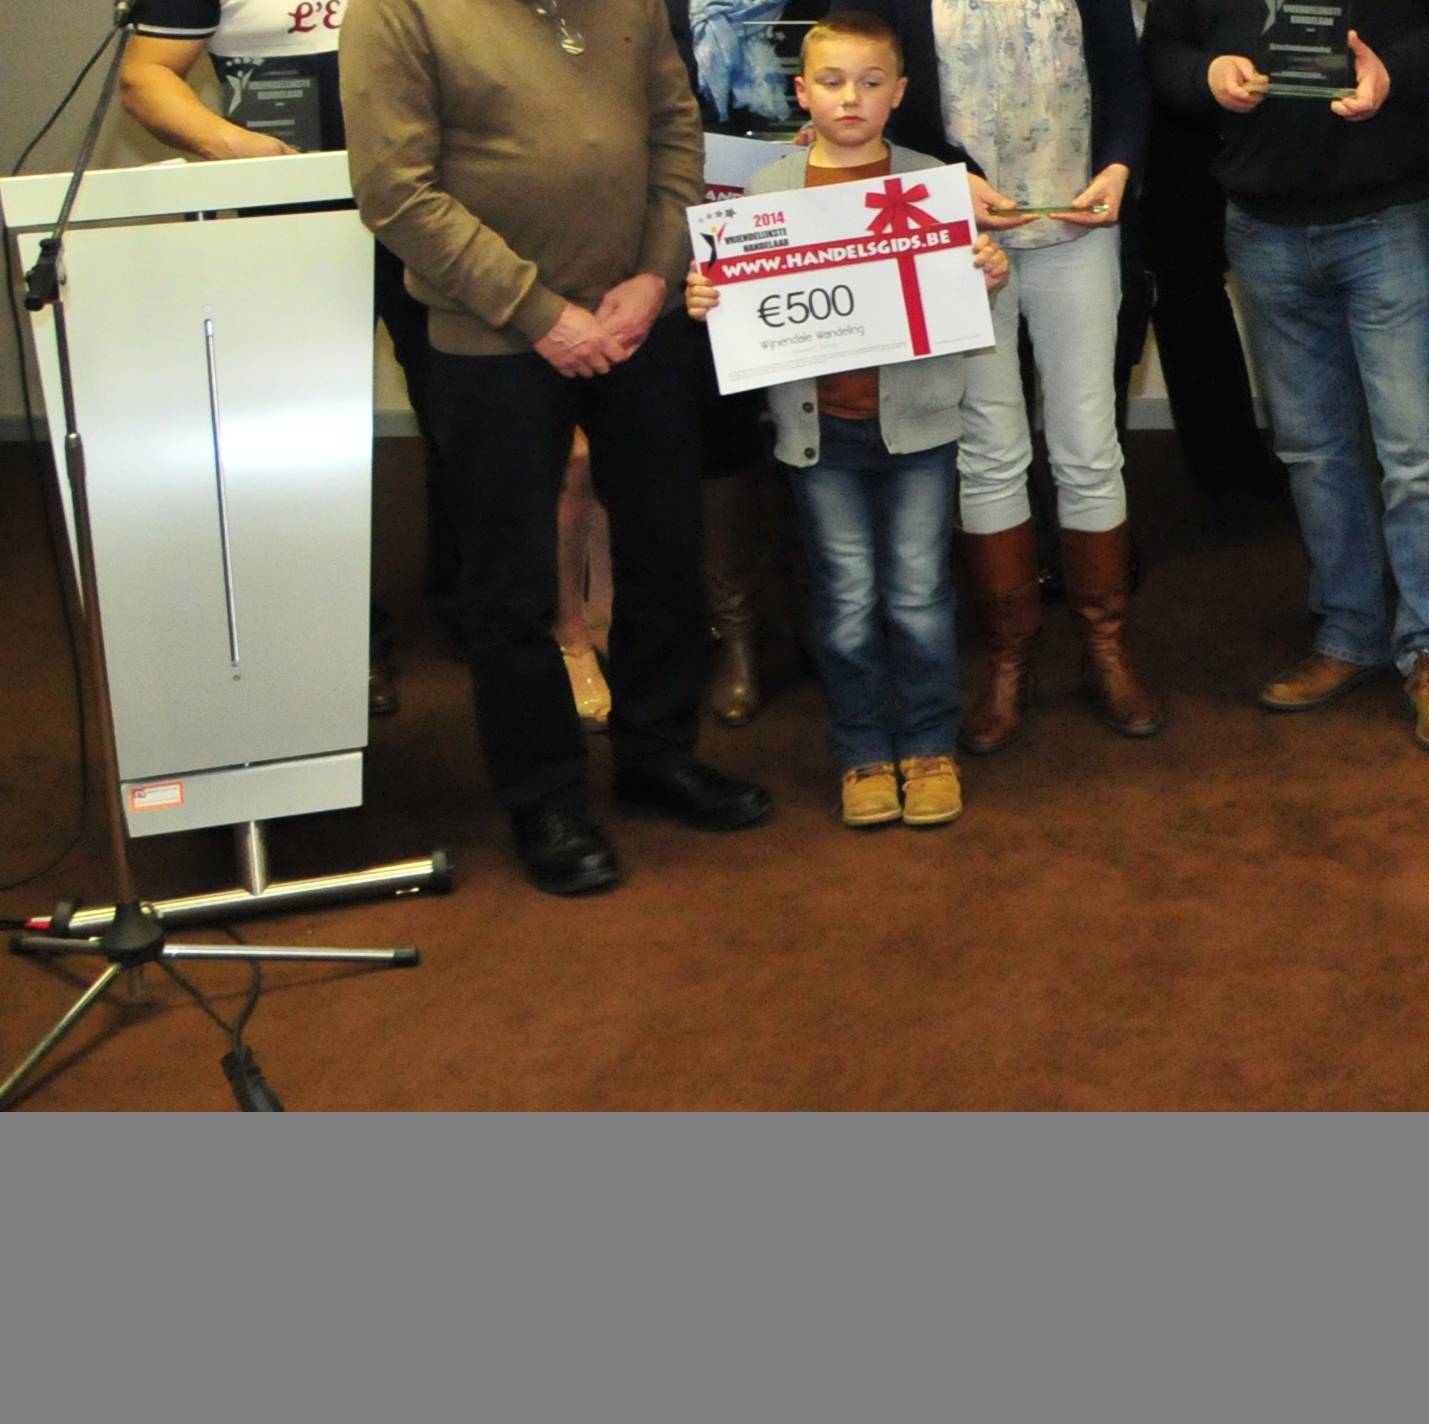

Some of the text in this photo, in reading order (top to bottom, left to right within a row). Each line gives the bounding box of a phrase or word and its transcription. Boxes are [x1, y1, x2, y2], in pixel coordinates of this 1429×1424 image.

[753, 211, 785, 228] 2014
[721, 229, 951, 278] WWW.HANDELSGIDS.BE
[757, 284, 855, 328] €500
